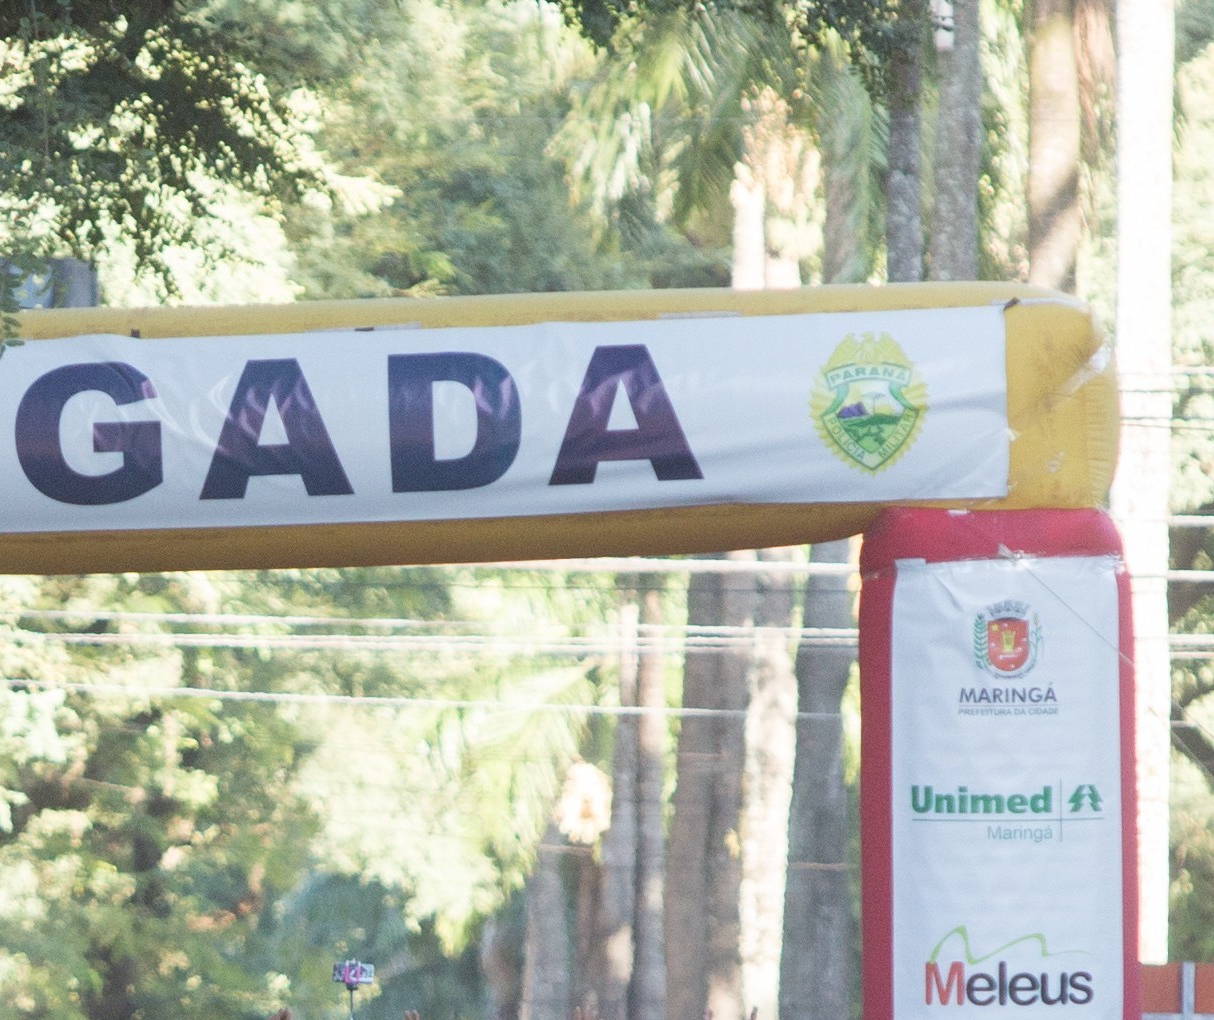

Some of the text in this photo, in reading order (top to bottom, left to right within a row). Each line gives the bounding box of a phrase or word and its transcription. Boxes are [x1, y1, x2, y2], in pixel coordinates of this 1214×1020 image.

[959, 682, 1058, 703] MARINGÁ
[911, 784, 1053, 815] Unimed
[987, 825, 1053, 842] Maringá
[925, 961, 1095, 1006] Meleus
